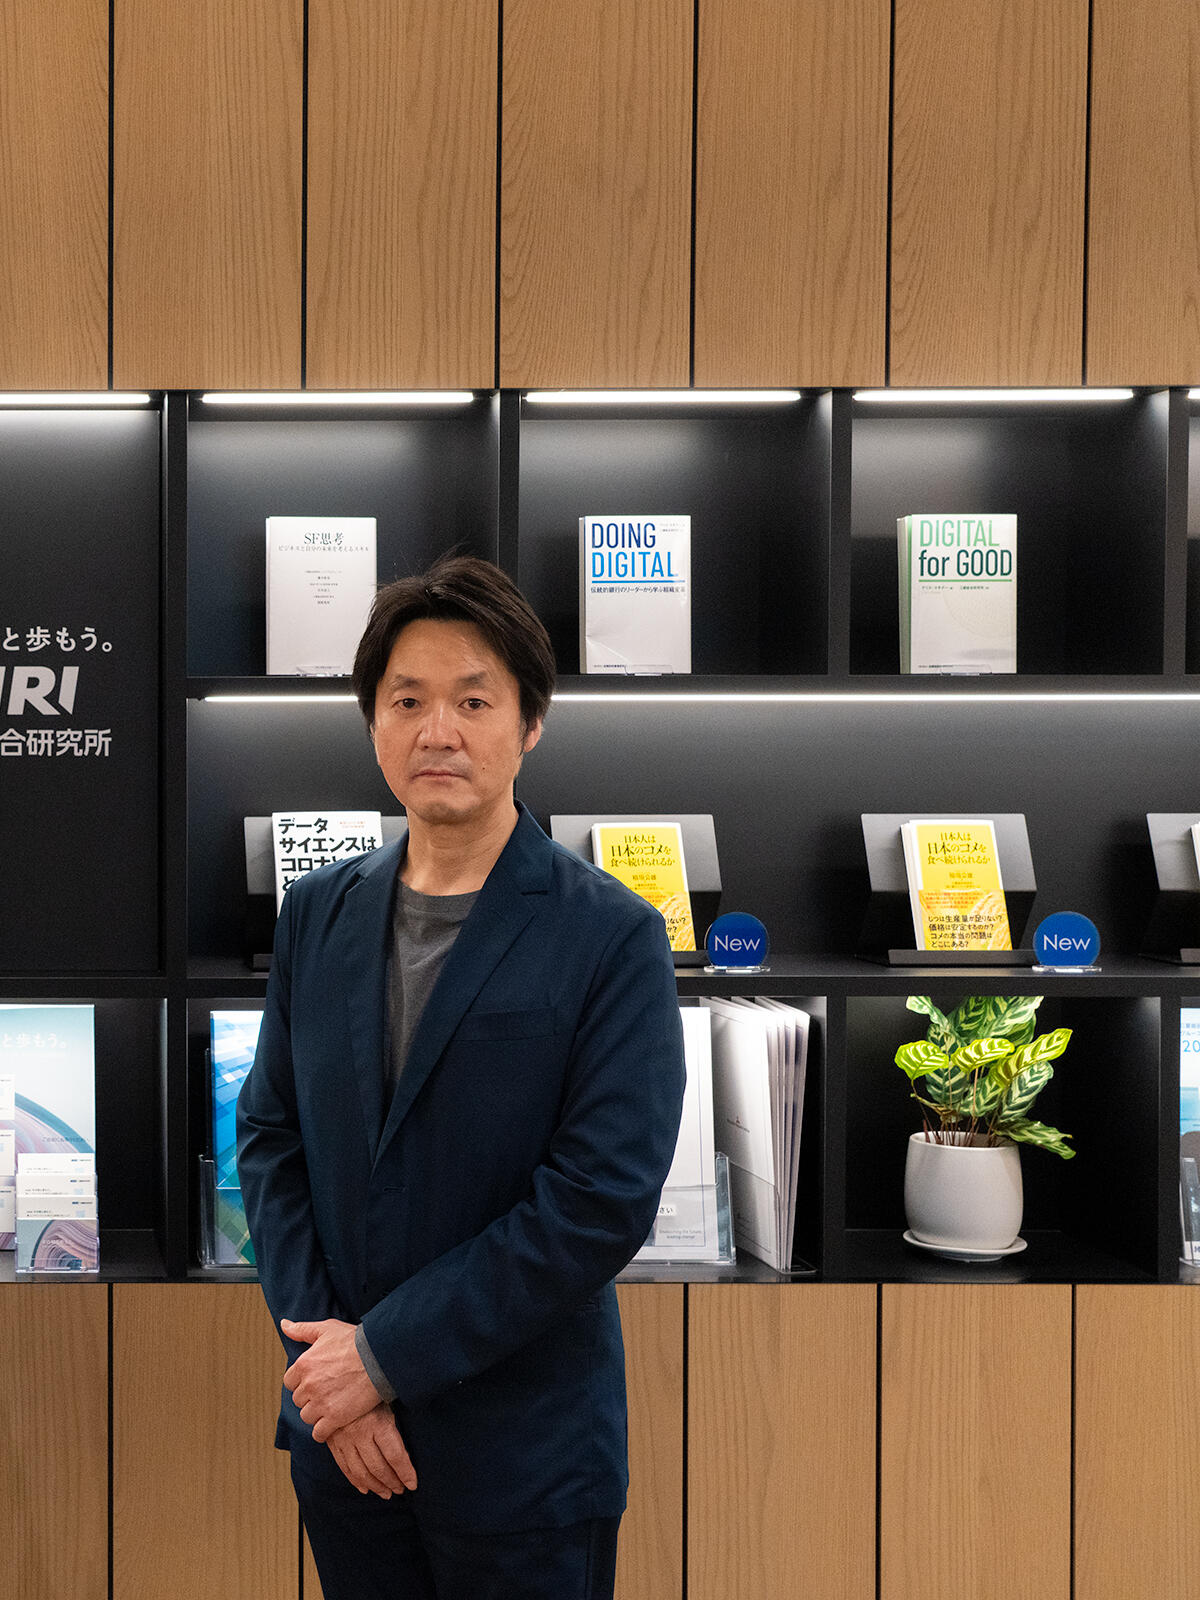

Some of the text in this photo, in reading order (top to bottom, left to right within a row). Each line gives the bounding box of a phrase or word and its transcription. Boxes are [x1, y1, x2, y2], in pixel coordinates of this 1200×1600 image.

[304, 532, 344, 545] SF思考
[591, 523, 656, 549] DOING
[919, 519, 1000, 547] DIGITAL
[591, 551, 679, 578] DIGITAL
[918, 549, 1013, 577] for GOOD
[278, 817, 328, 834] データ
[624, 835, 656, 844] 日本人は
[940, 832, 971, 841] 日本人は
[279, 836, 377, 854] サイエンスは
[611, 844, 672, 857] 日本のコメを
[927, 842, 987, 855] 日本のコメを
[281, 855, 343, 872] コロナ
[610, 857, 675, 868] 食べ続けられるか
[927, 856, 991, 865] 食べ続けられるか
[282, 876, 304, 891] ど
[714, 935, 761, 951] New
[1043, 934, 1091, 951] New
